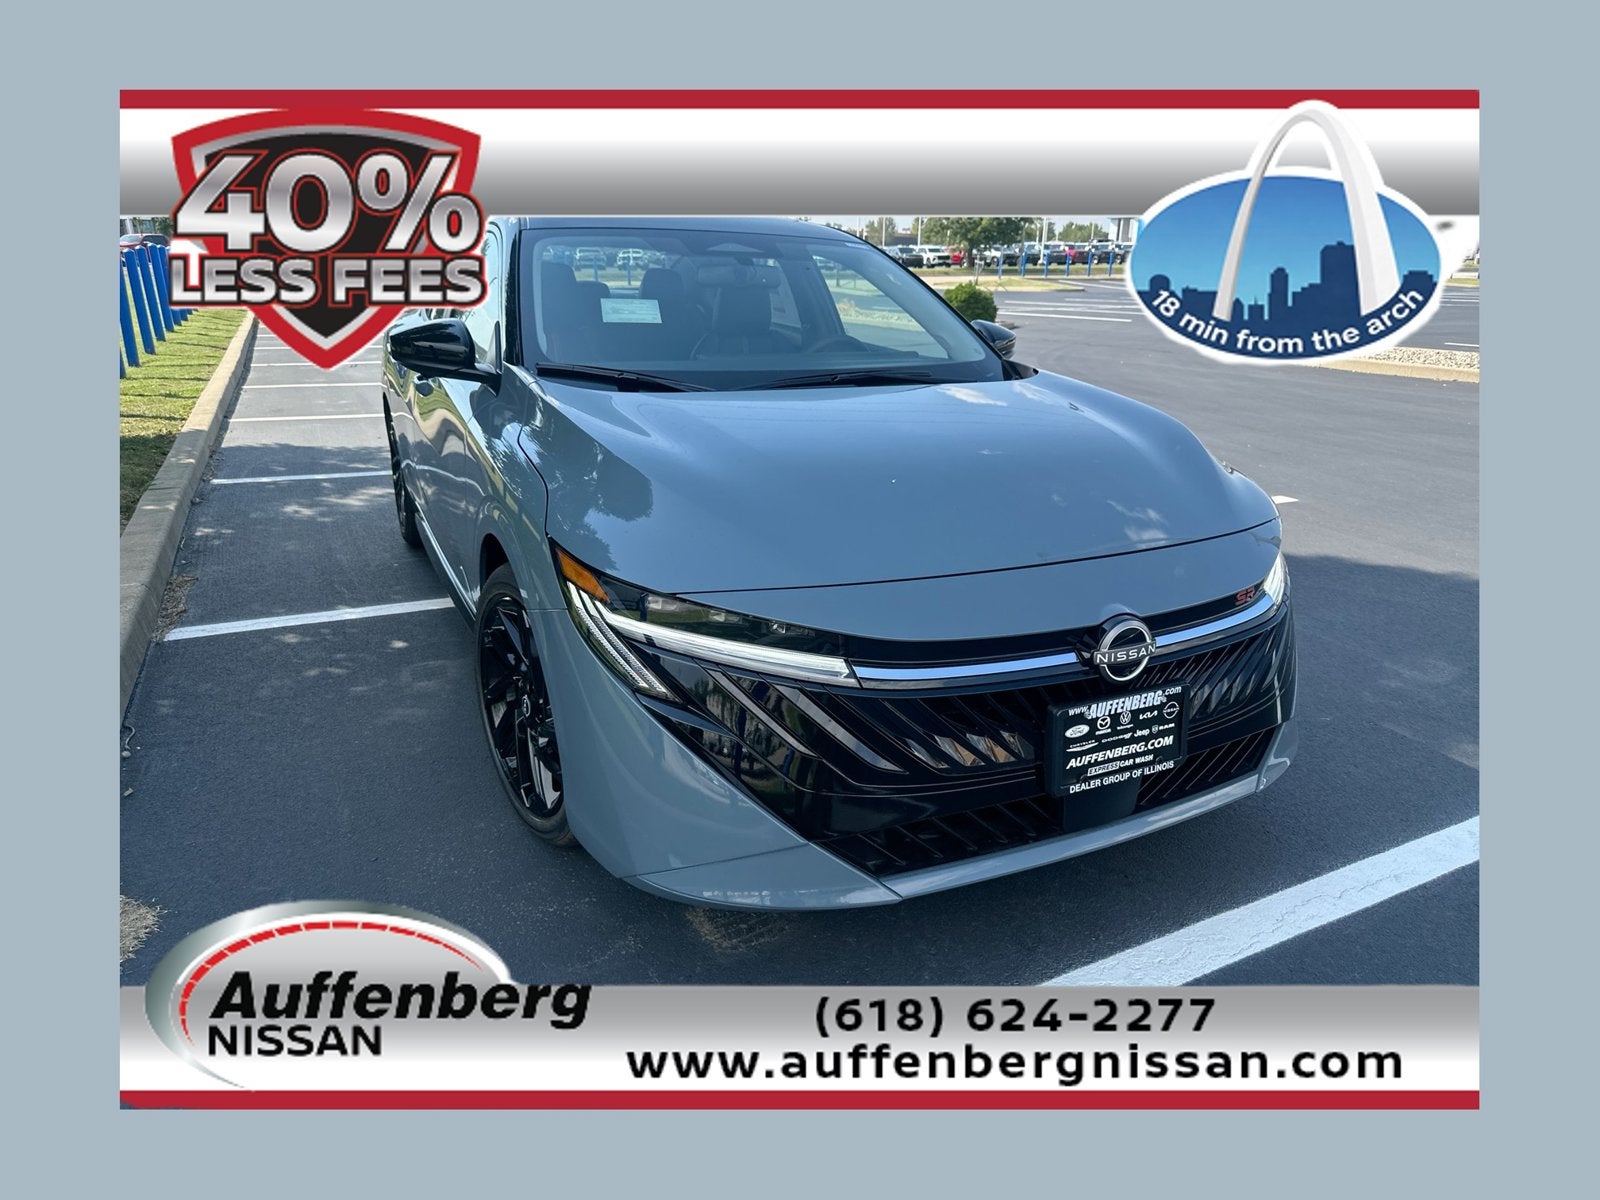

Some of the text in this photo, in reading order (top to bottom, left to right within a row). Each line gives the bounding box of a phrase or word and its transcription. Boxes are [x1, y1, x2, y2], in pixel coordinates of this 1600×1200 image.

[1235, 587, 1256, 605] SR
[1096, 642, 1156, 664] NISSAN
[1133, 728, 1150, 738] Jeep
[1158, 722, 1176, 731] RAM
[1066, 735, 1174, 770] AUFFENBERG.COM
[1088, 754, 1154, 775] EXPRESS CAR WASH
[1069, 760, 1175, 794] DEALER GROUP OF ILLINOIS
